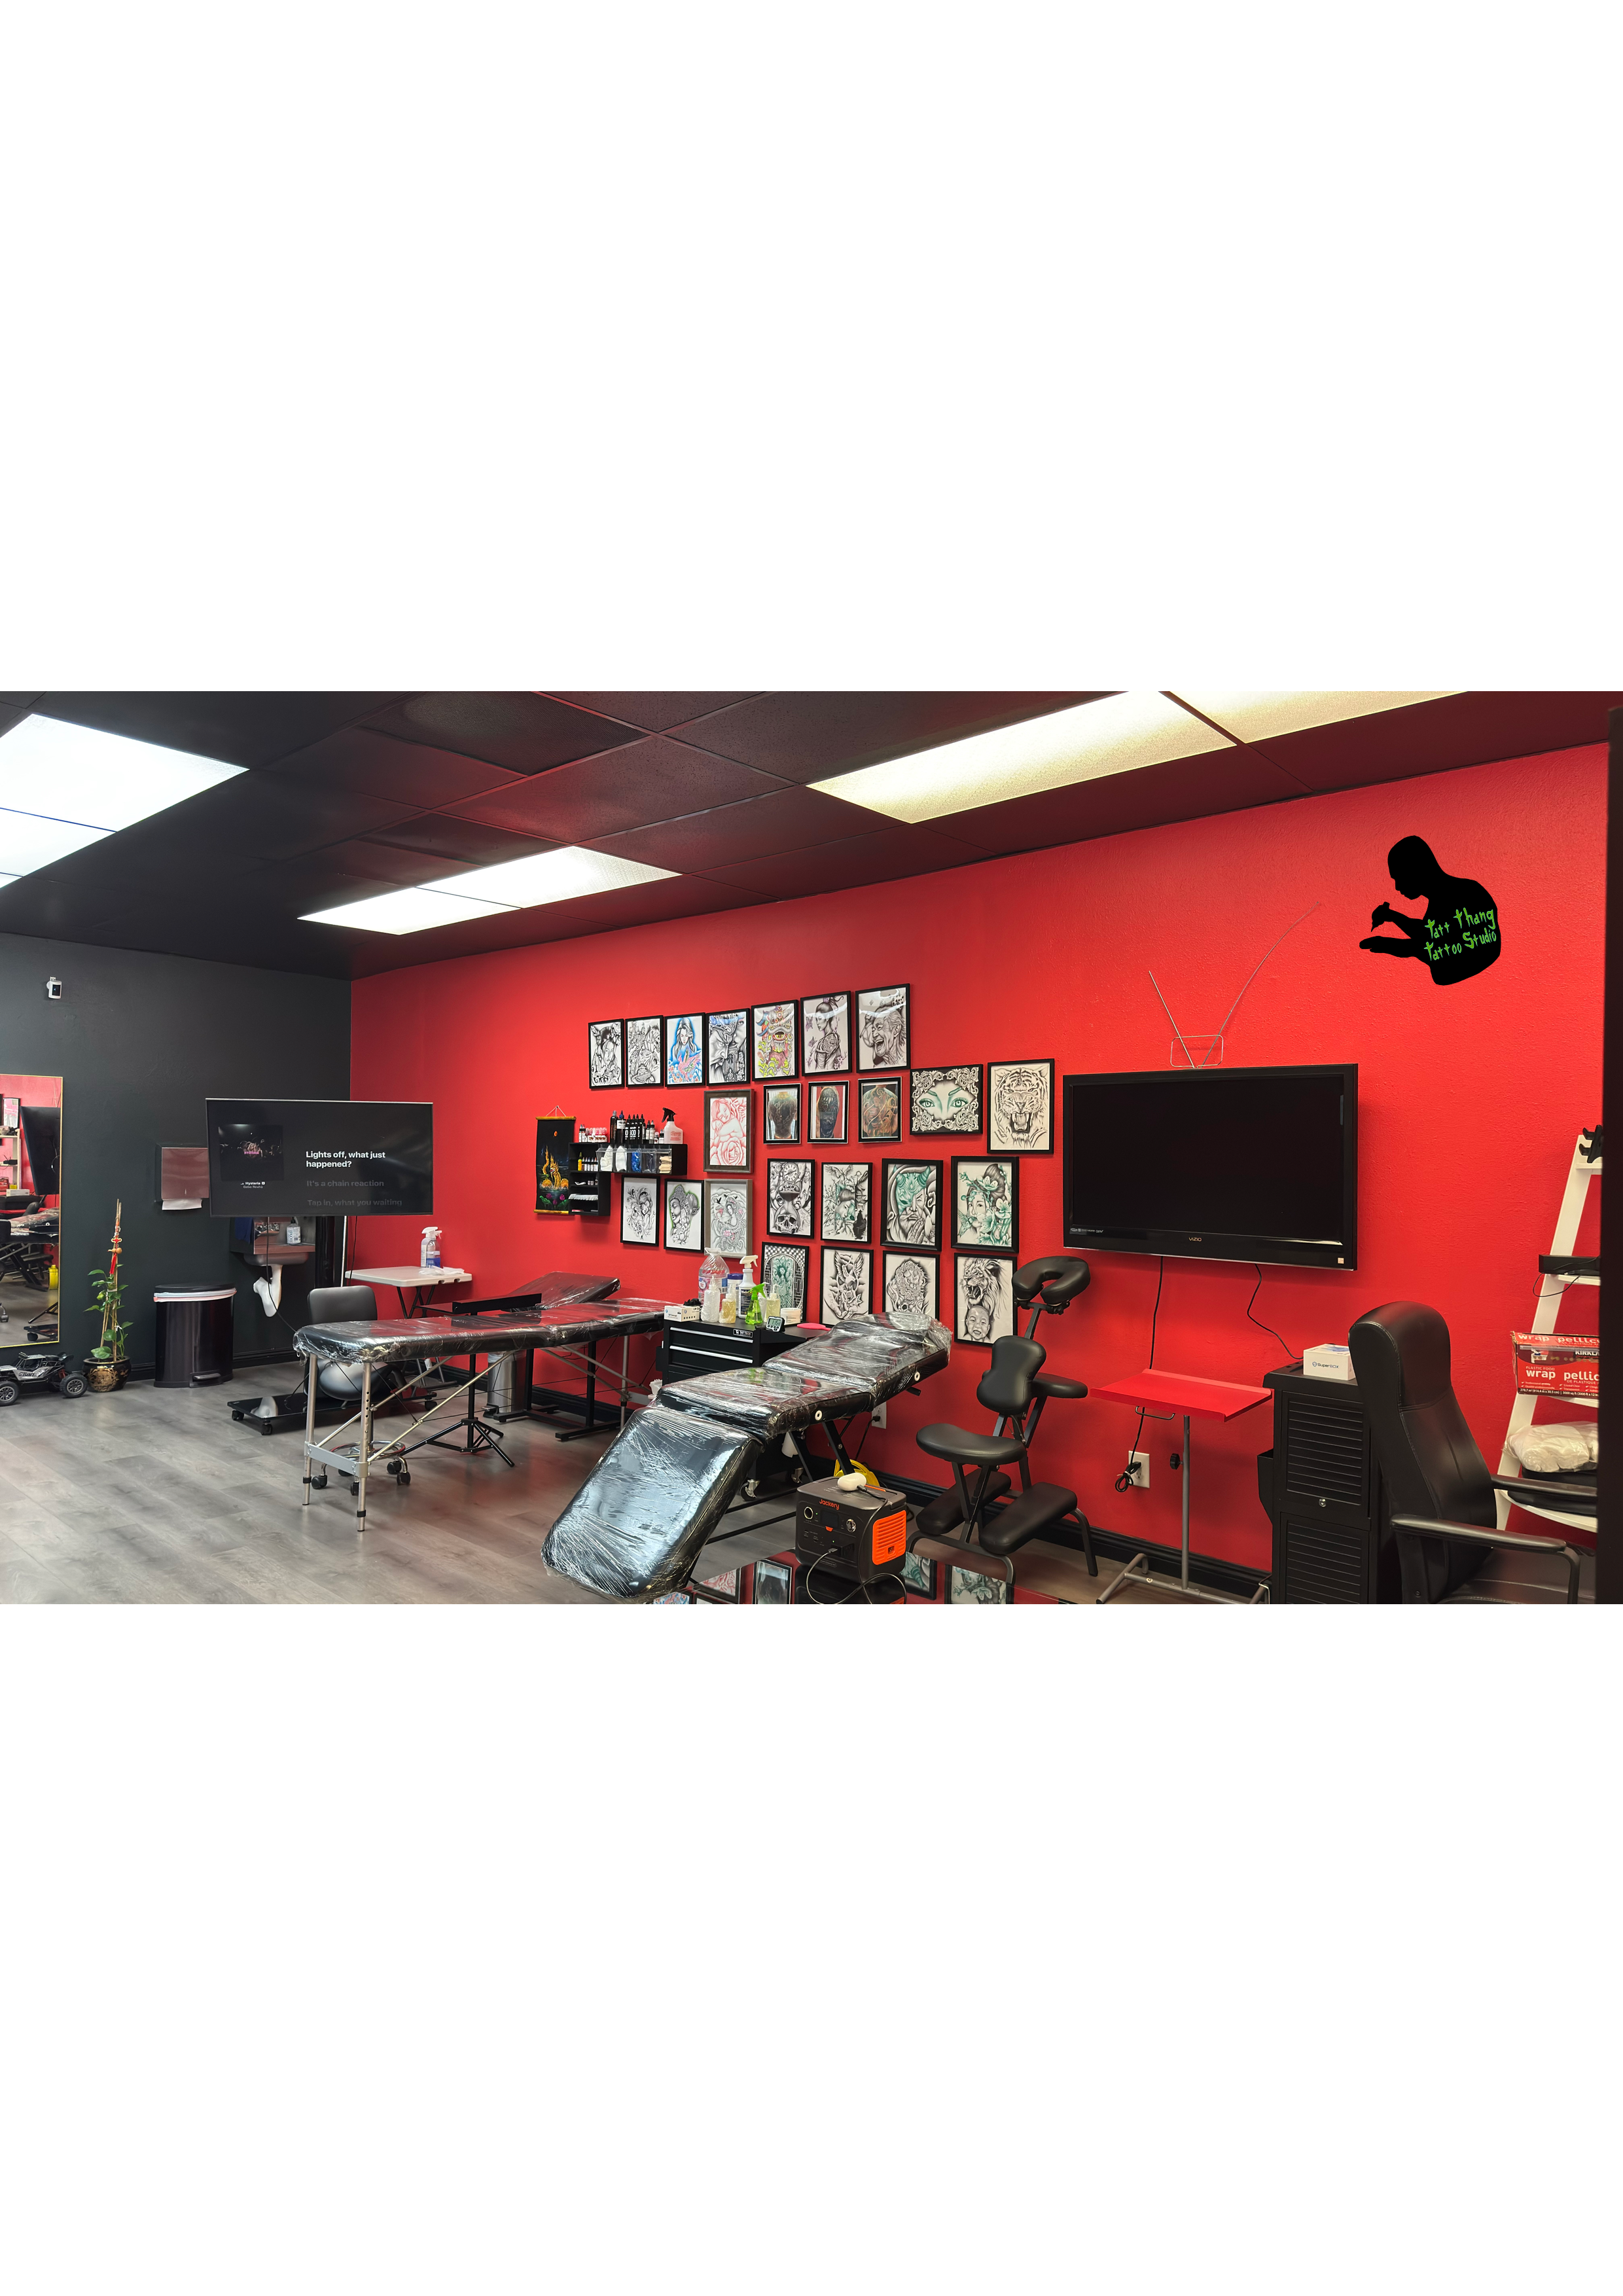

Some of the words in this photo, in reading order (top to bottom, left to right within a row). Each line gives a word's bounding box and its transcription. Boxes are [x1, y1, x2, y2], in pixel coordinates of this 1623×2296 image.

[306, 1151, 332, 1159] Lights
[333, 1151, 347, 1159] off,
[1526, 1370, 1556, 1380] wrap
[819, 1499, 840, 1511] Jackery
